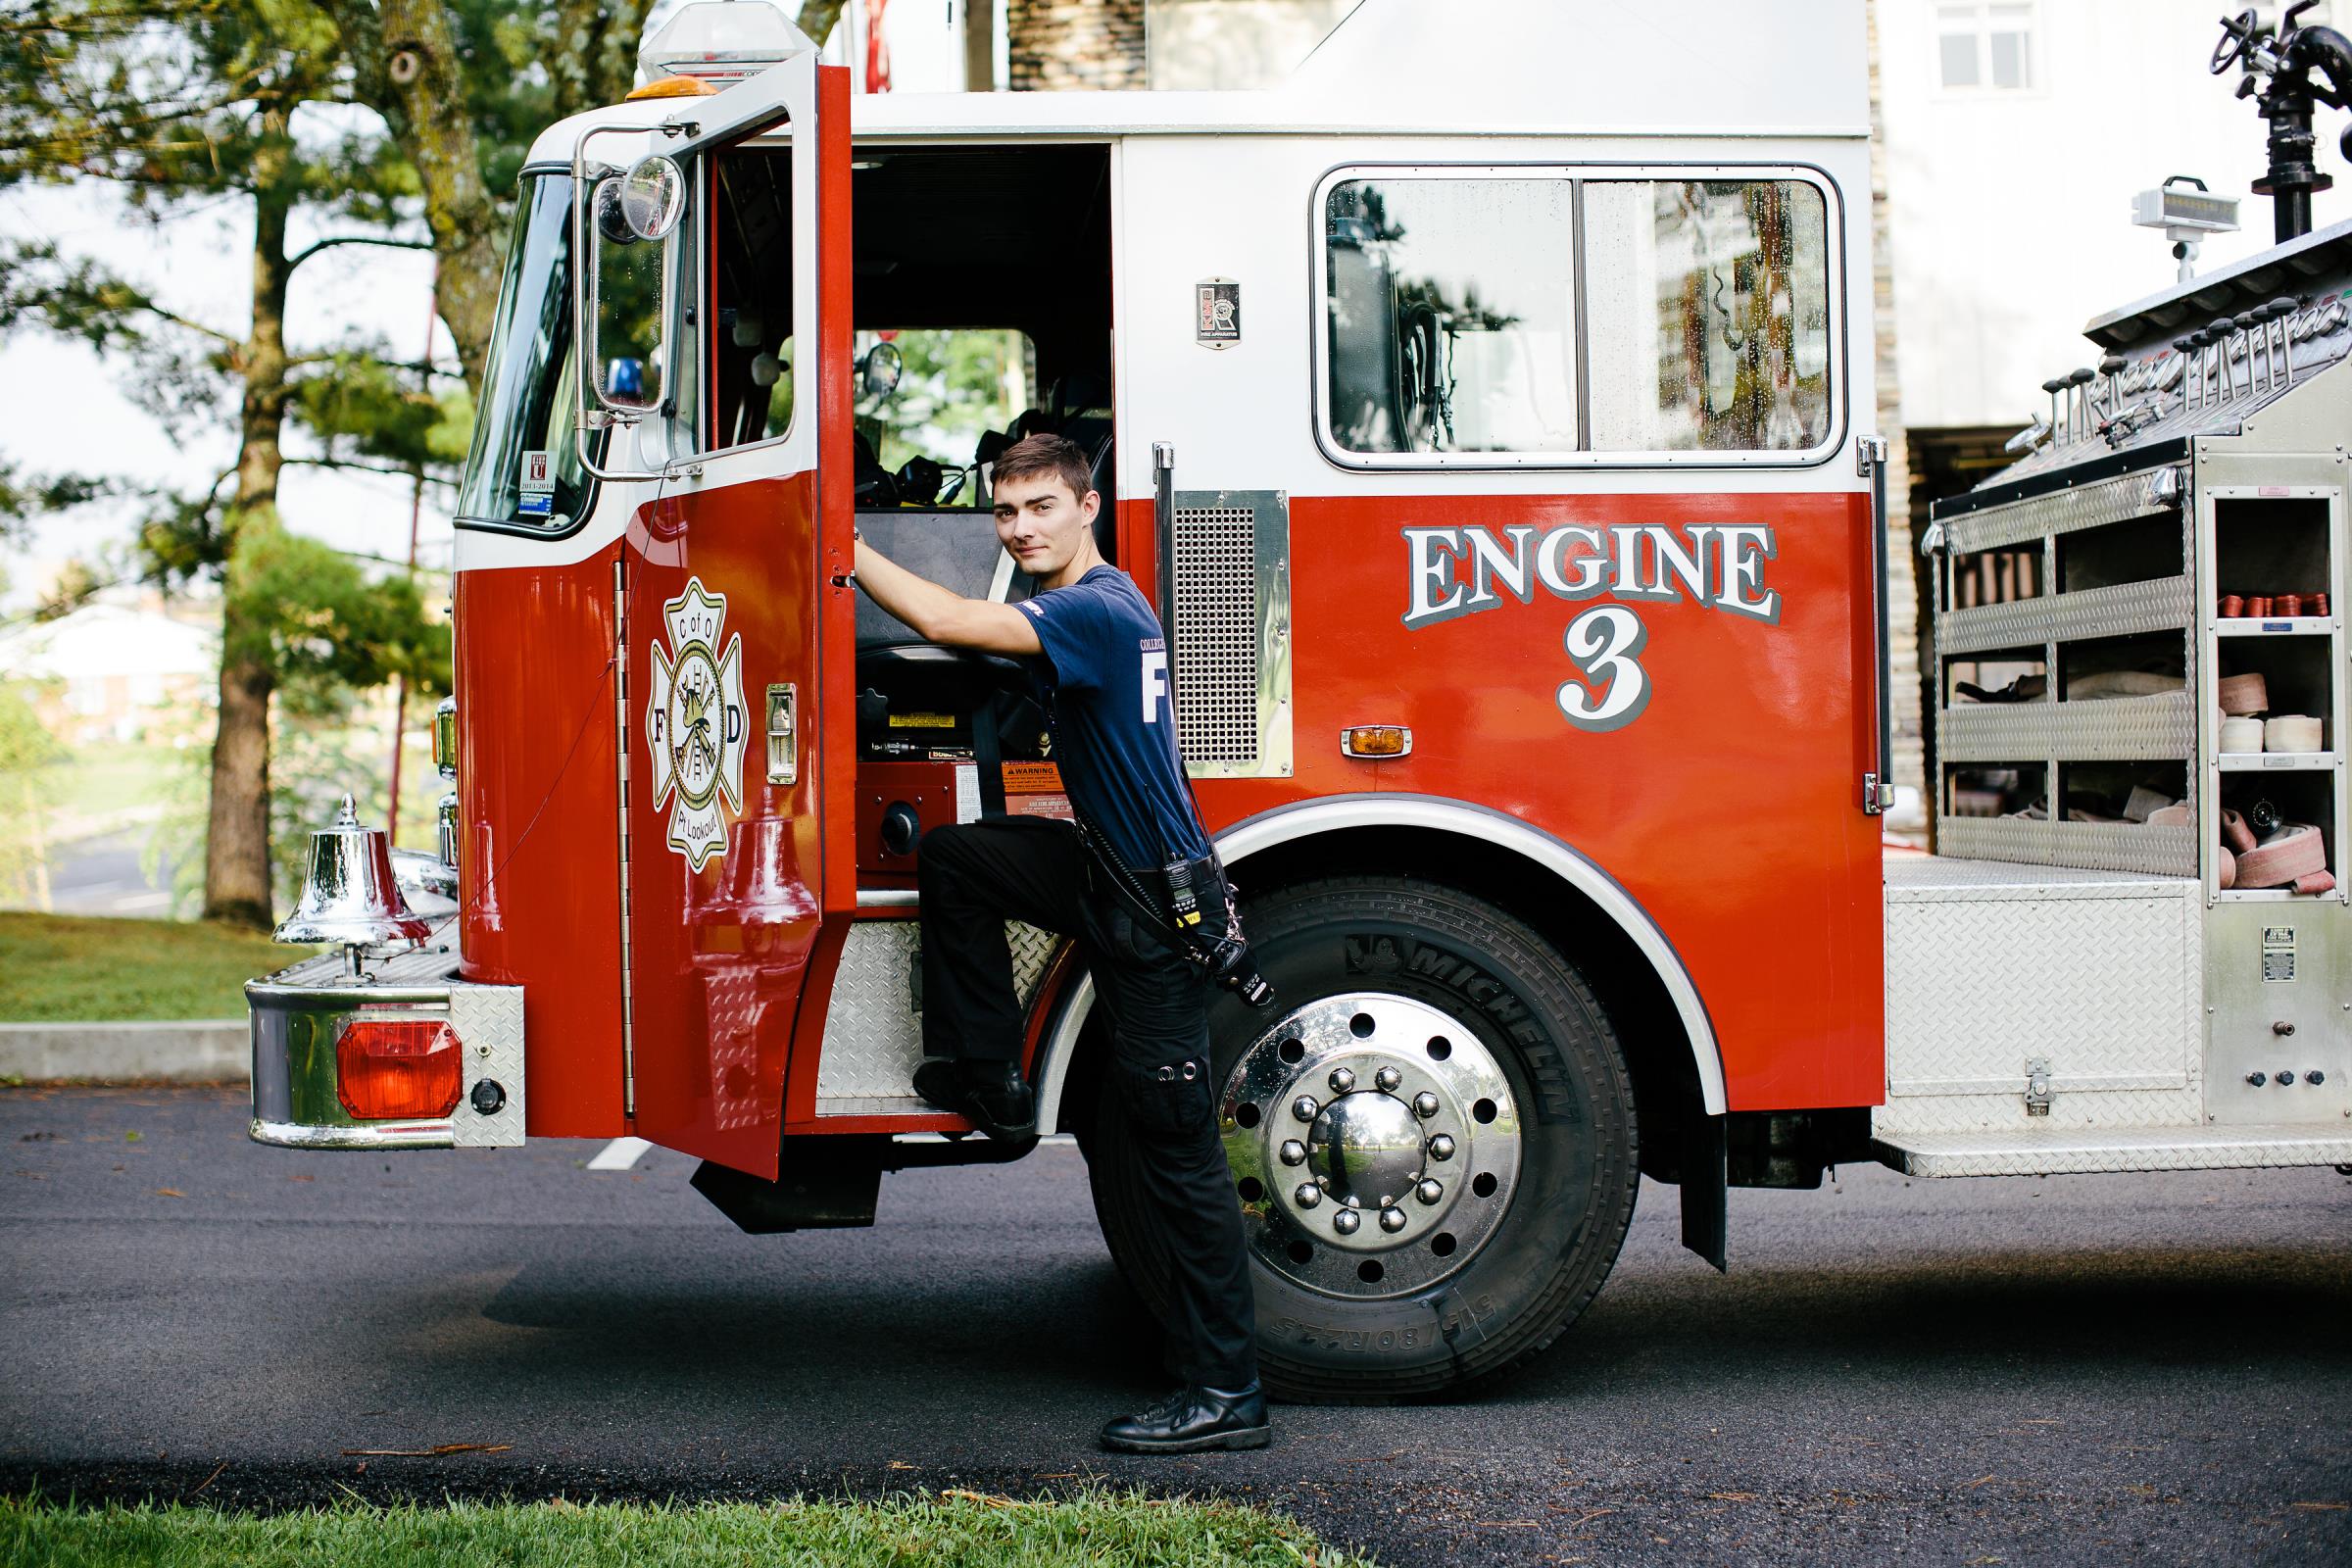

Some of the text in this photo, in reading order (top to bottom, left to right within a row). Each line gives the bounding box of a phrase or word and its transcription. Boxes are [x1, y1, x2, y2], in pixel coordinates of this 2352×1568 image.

[1401, 523, 1782, 629] ENGINE
[679, 612, 712, 644] C of O
[1556, 604, 1651, 732] 3
[654, 705, 742, 743] F D
[678, 810, 717, 841] Pt Lookout
[1408, 947, 1573, 1117] MICHELIN
